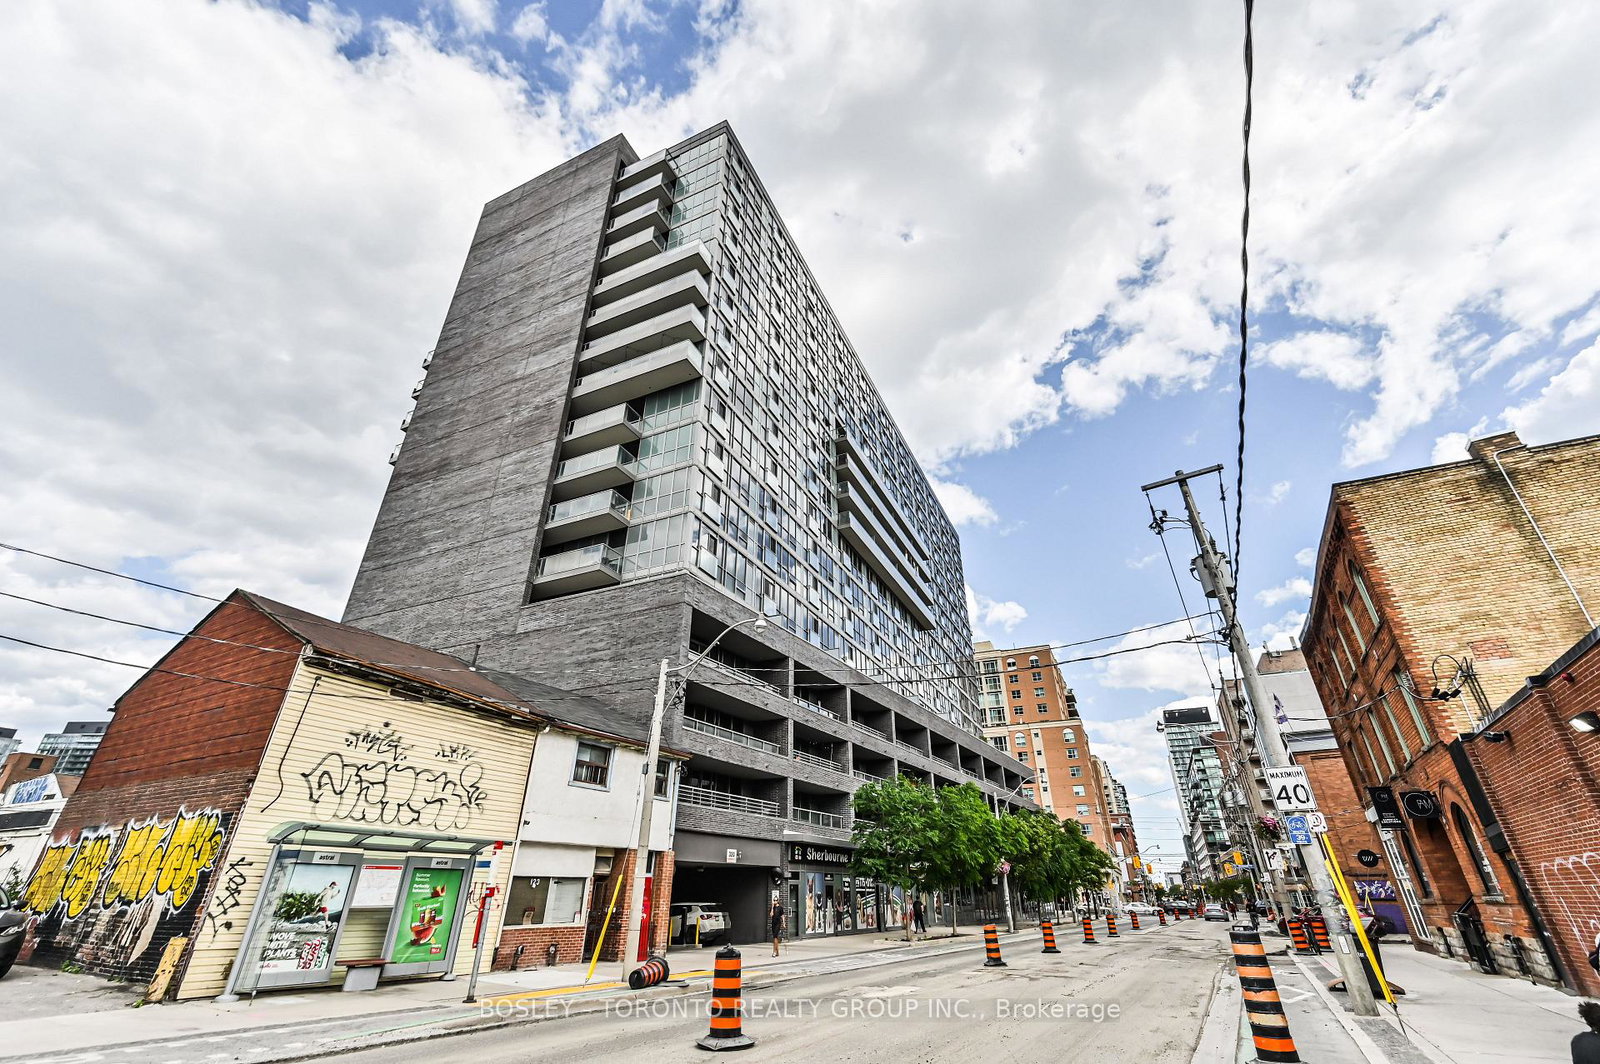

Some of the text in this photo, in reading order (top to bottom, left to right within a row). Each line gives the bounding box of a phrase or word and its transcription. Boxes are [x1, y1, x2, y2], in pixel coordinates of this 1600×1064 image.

[1269, 770, 1303, 779] MAXIMUM
[1276, 783, 1310, 804] 40
[806, 847, 848, 863] Sherbourne
[269, 932, 296, 940] MOVE
